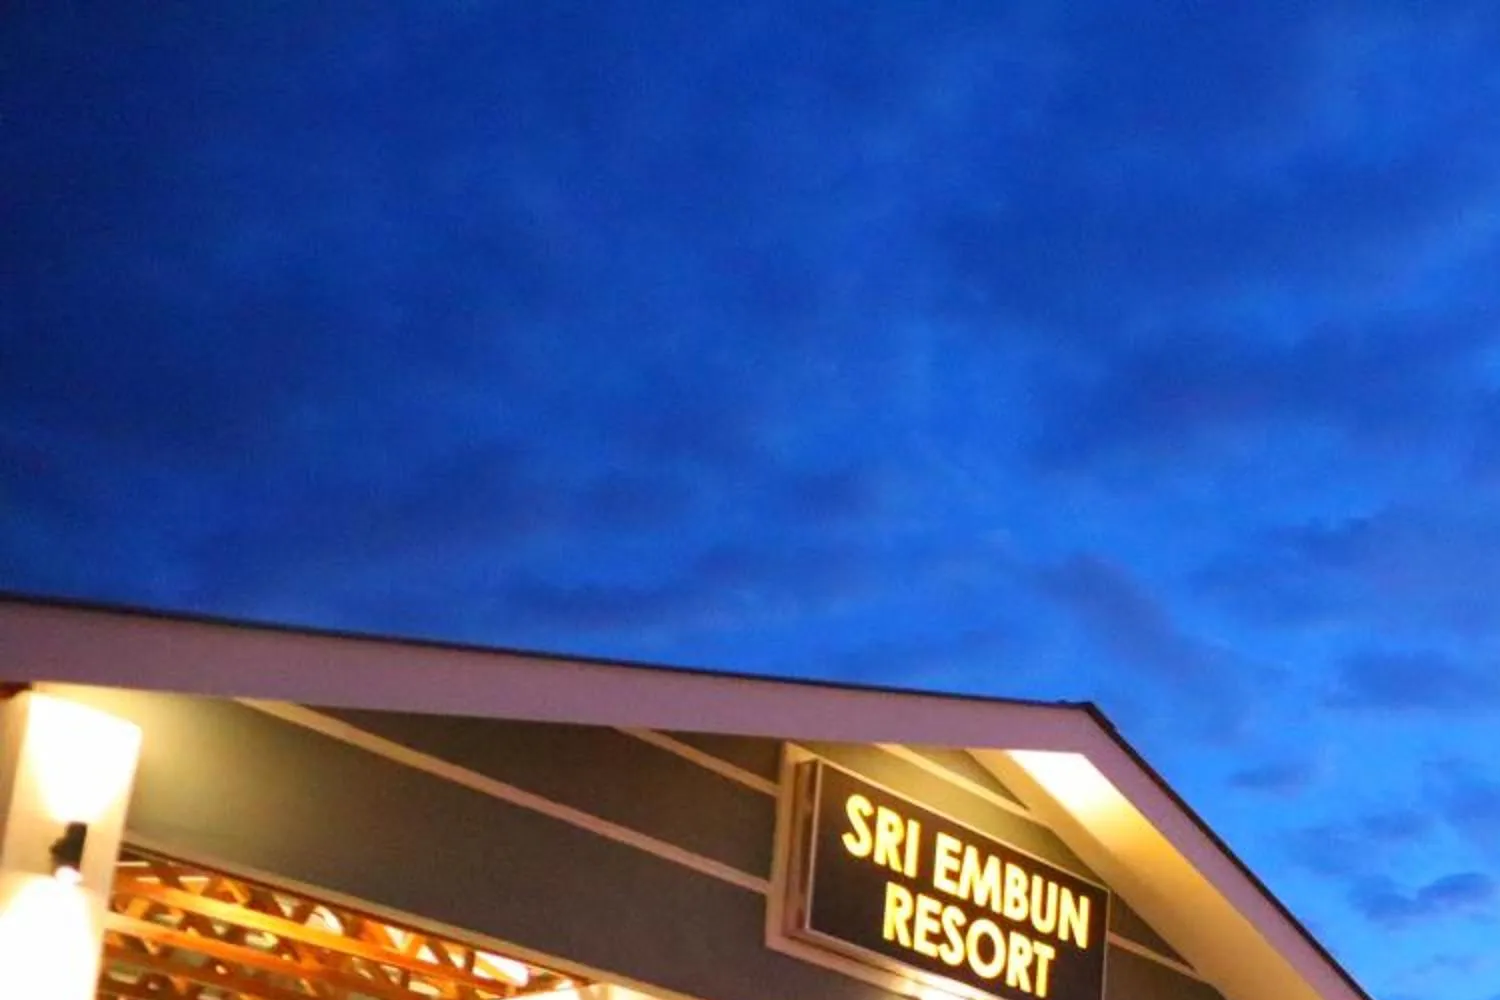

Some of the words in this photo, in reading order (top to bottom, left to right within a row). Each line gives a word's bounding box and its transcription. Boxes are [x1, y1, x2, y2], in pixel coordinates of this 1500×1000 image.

[841, 794, 921, 877] SRI
[933, 832, 1090, 949] EMBUN
[883, 881, 1055, 998] RESORT
